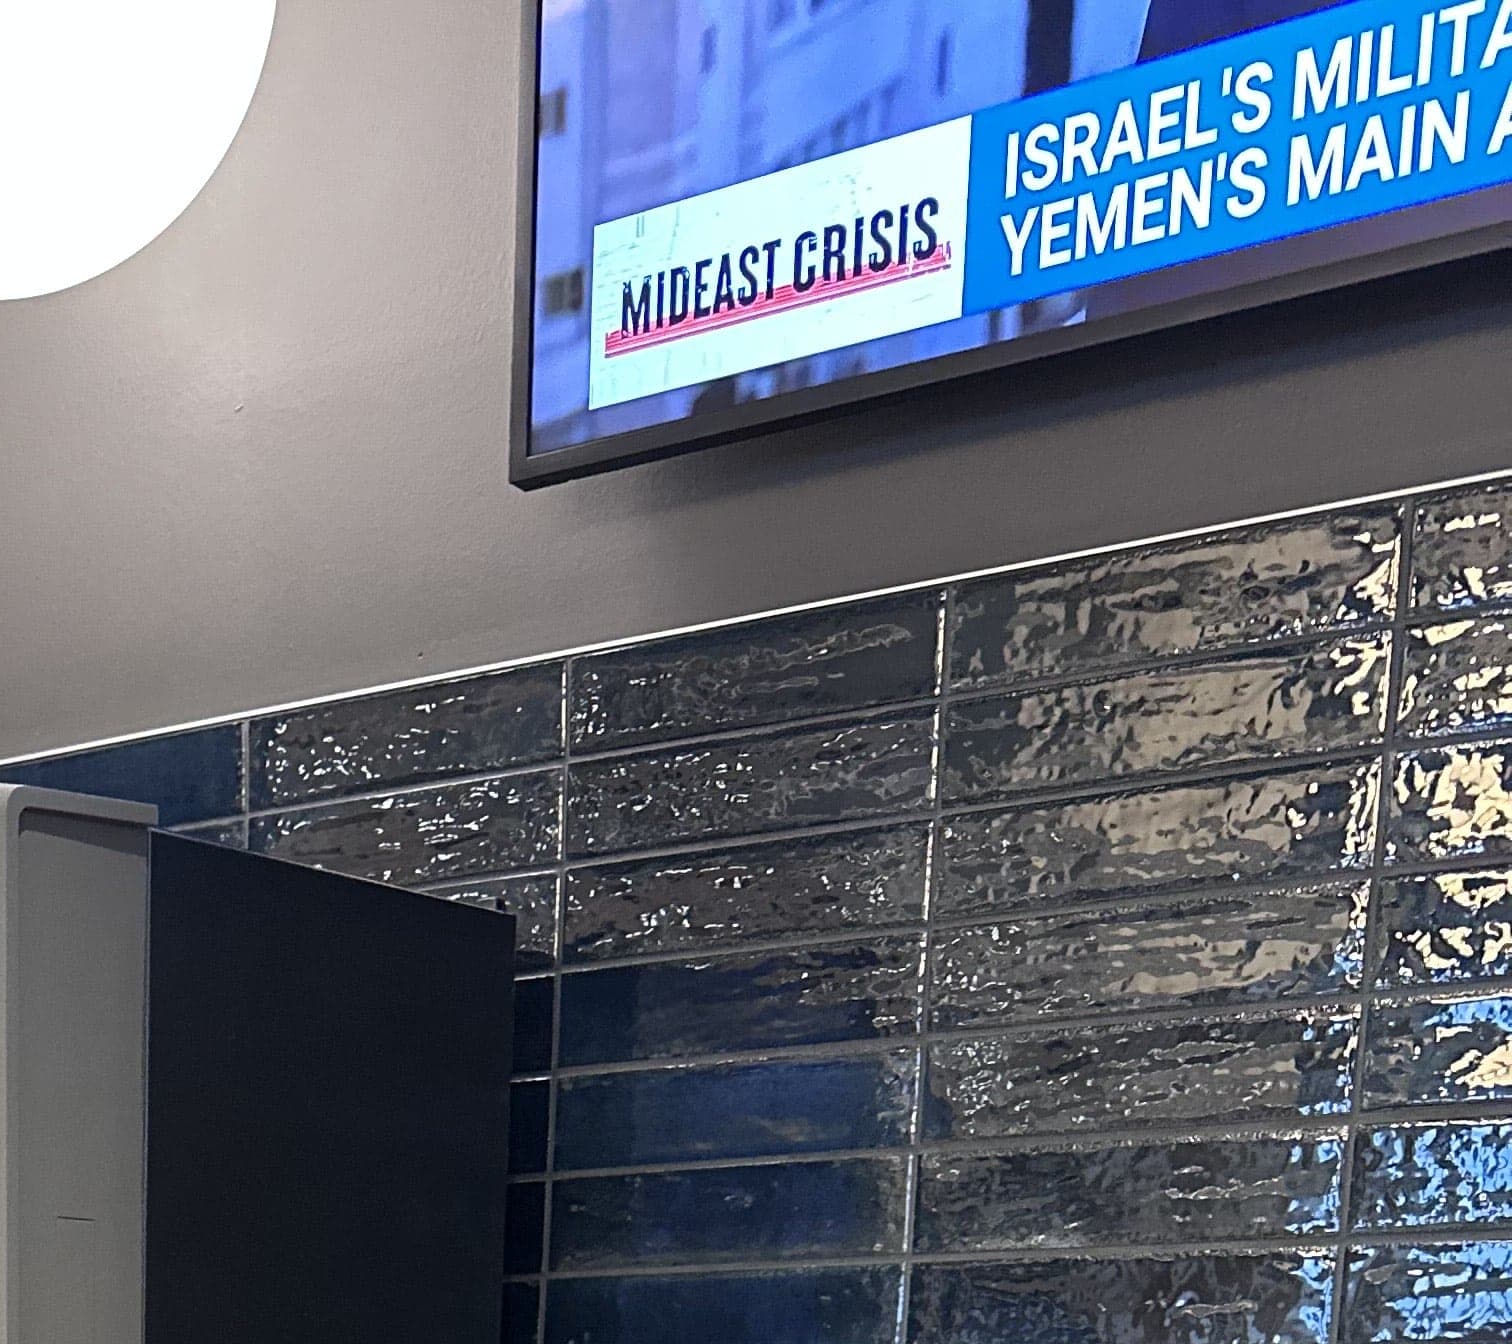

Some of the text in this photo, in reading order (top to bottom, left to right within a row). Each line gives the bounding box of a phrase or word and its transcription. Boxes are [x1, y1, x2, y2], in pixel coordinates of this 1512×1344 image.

[999, 146, 1269, 277] YEMEN'S
[1286, 88, 1471, 208] MAIN
[1004, 60, 1274, 201] ISRAEL'S
[620, 196, 939, 340] MIDEAST CRISIS
